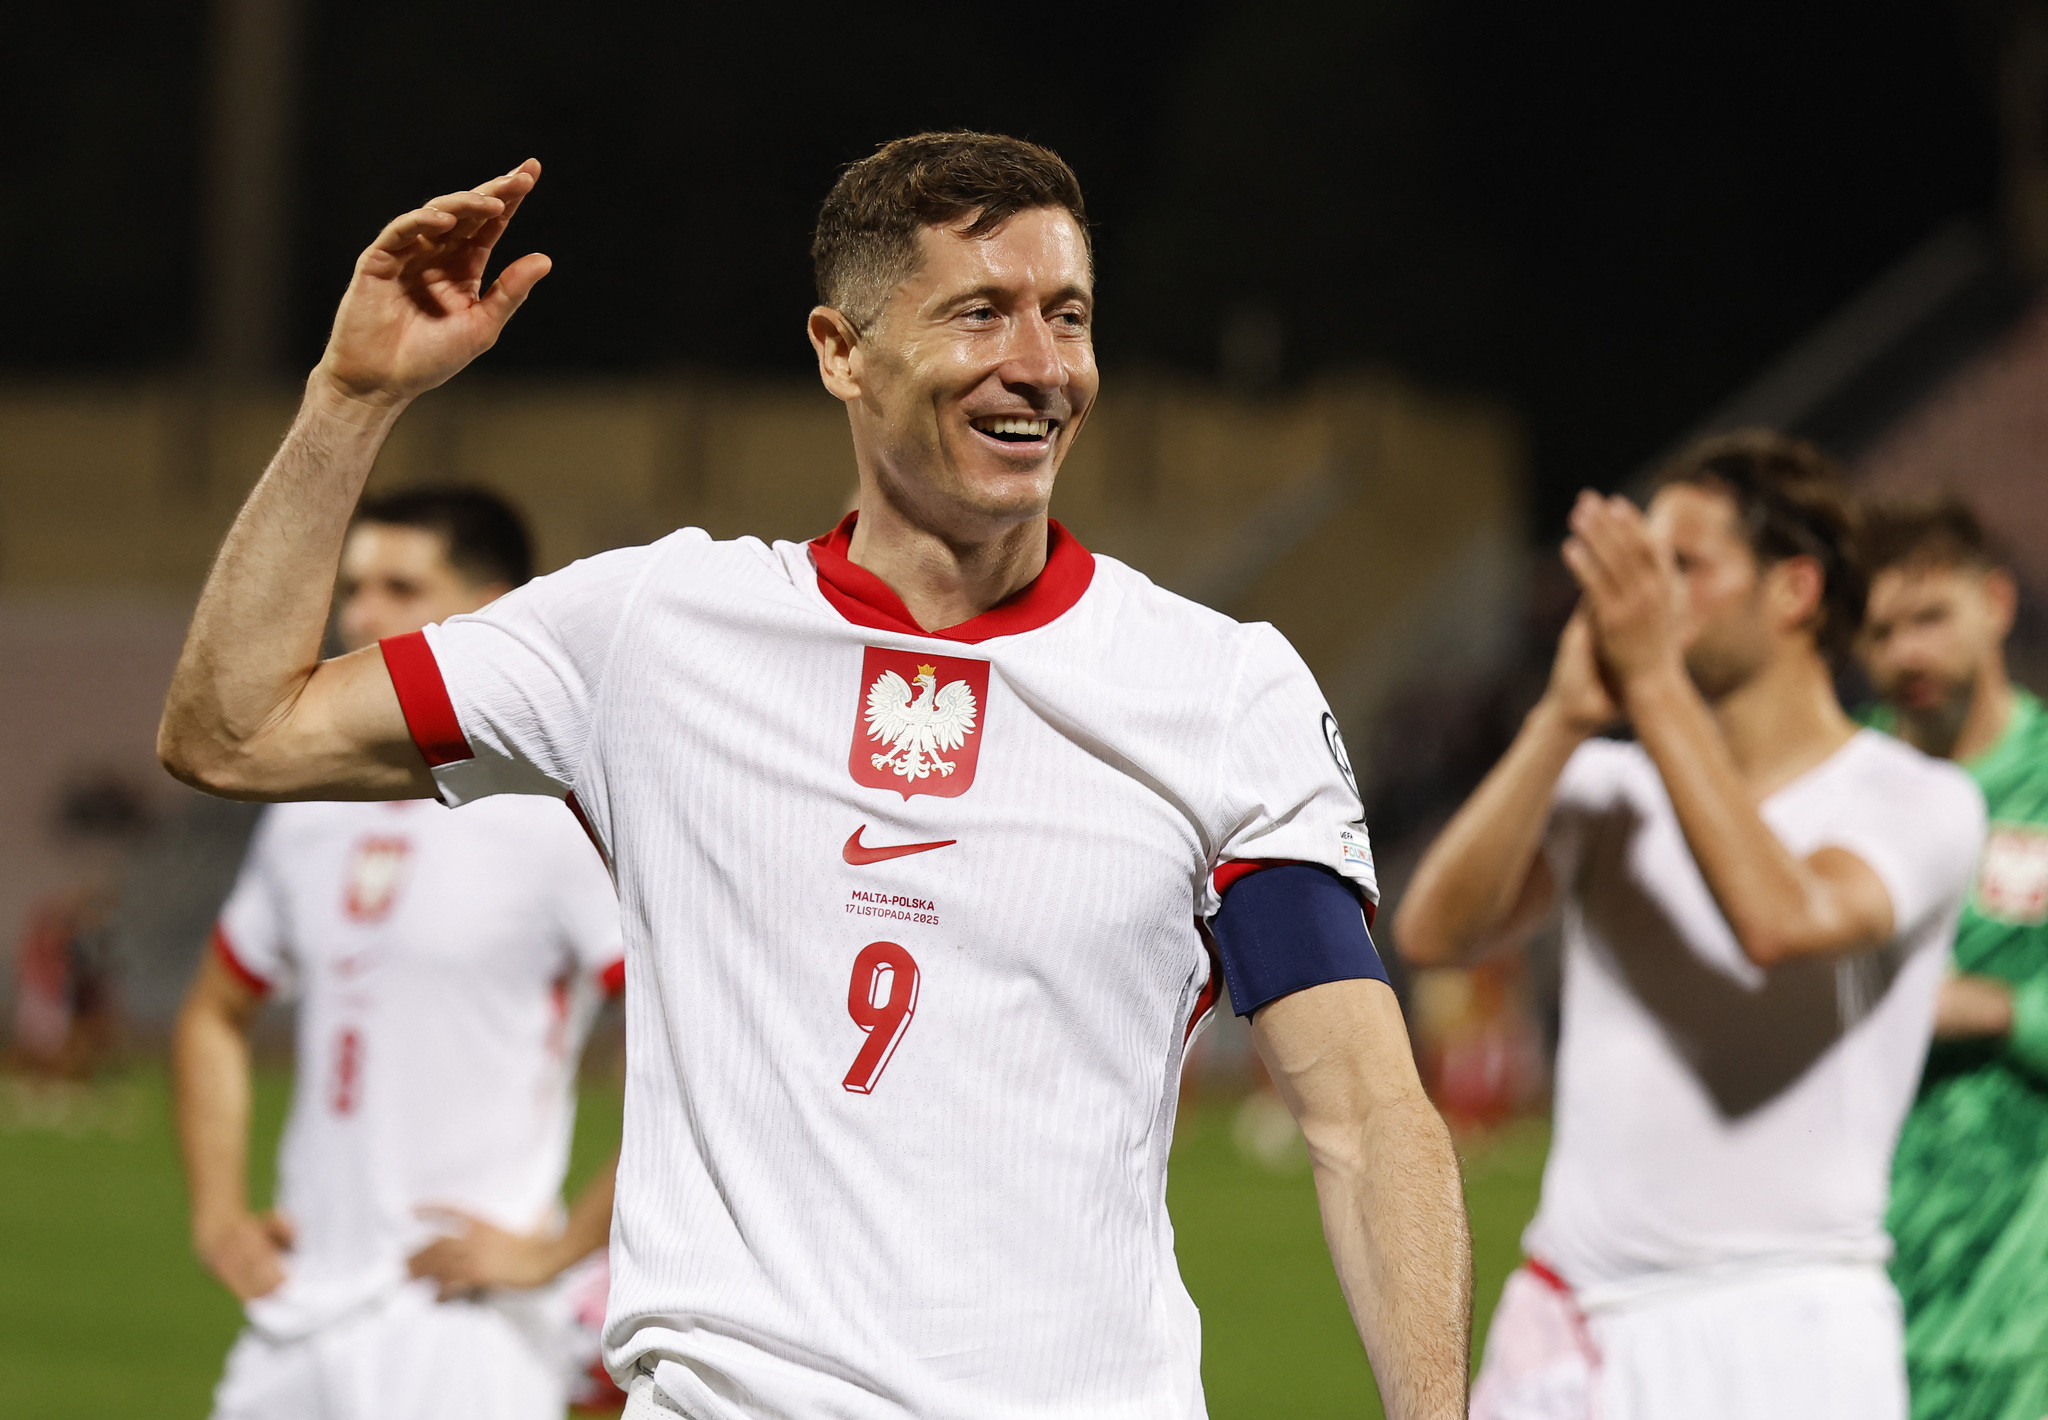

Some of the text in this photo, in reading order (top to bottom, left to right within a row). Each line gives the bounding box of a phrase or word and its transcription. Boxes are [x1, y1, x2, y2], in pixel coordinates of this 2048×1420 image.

[852, 890, 935, 911] MALTA-POLSKA
[845, 904, 939, 926] 17 LISTOPADA 2025
[842, 941, 920, 1095] 9
